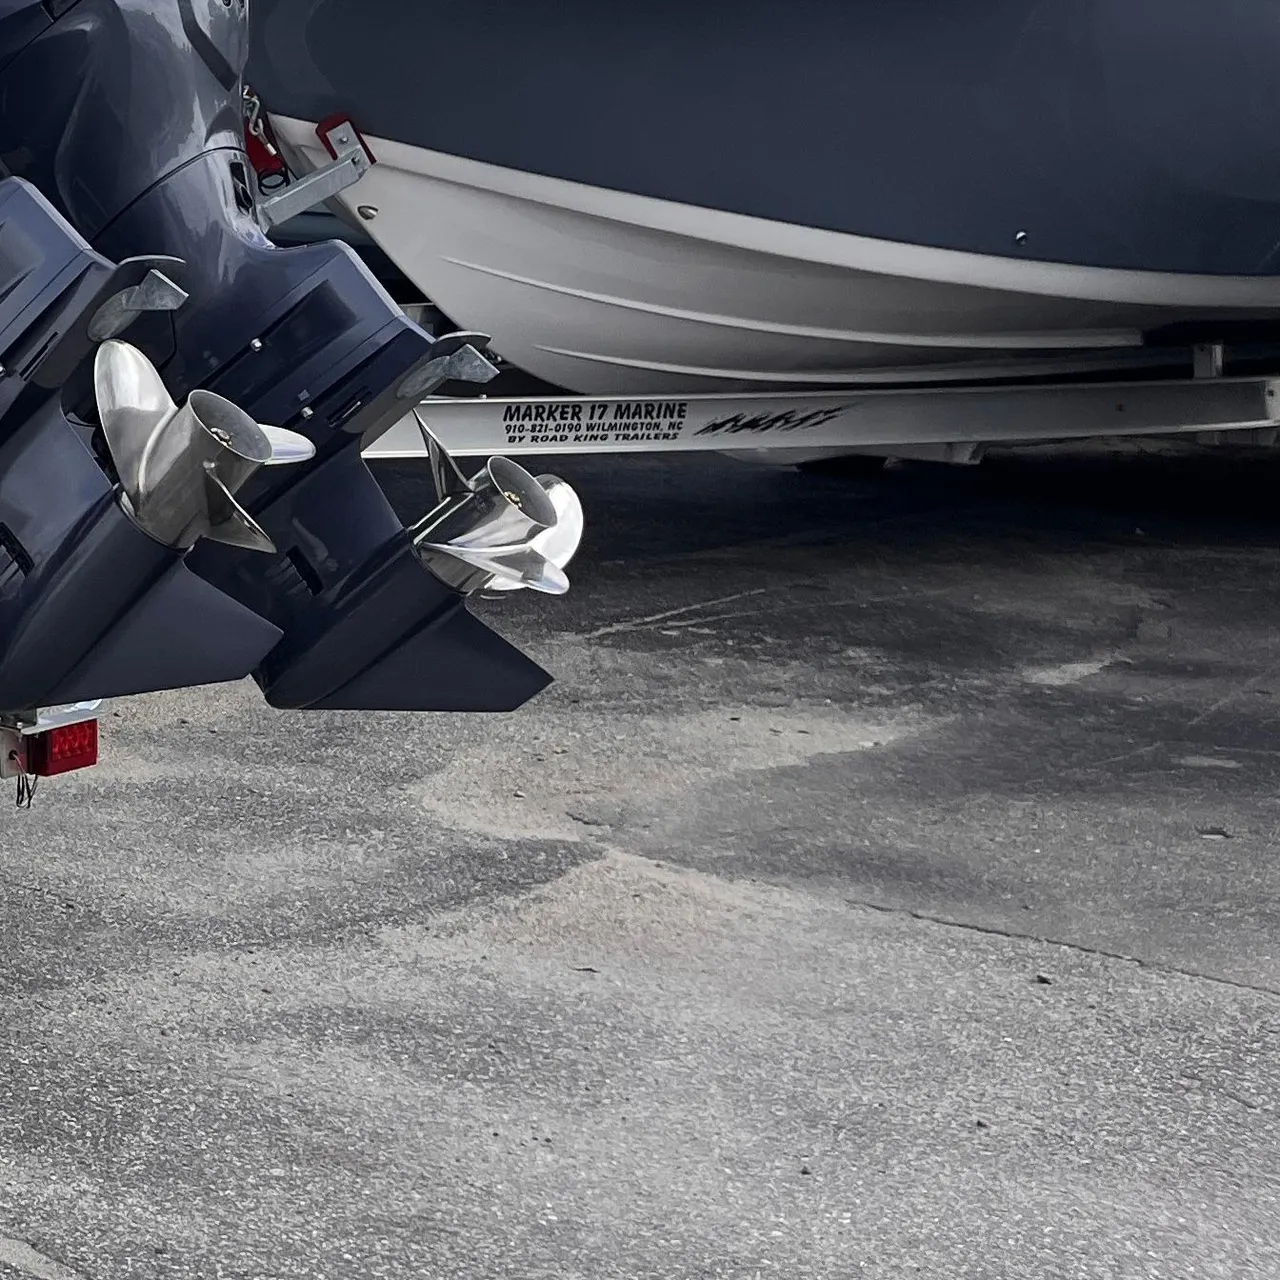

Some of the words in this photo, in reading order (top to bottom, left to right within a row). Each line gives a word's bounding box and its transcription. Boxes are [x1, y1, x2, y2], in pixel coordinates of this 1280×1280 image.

[502, 404, 583, 422] MARKER
[589, 403, 609, 420] 17
[613, 403, 688, 420] MARINE
[504, 423, 582, 434] 910-821-0190
[667, 421, 684, 431] NC
[507, 435, 526, 443] BY
[530, 434, 569, 443] ROAD
[573, 433, 609, 442] KING
[613, 432, 680, 441] TRAILERS
